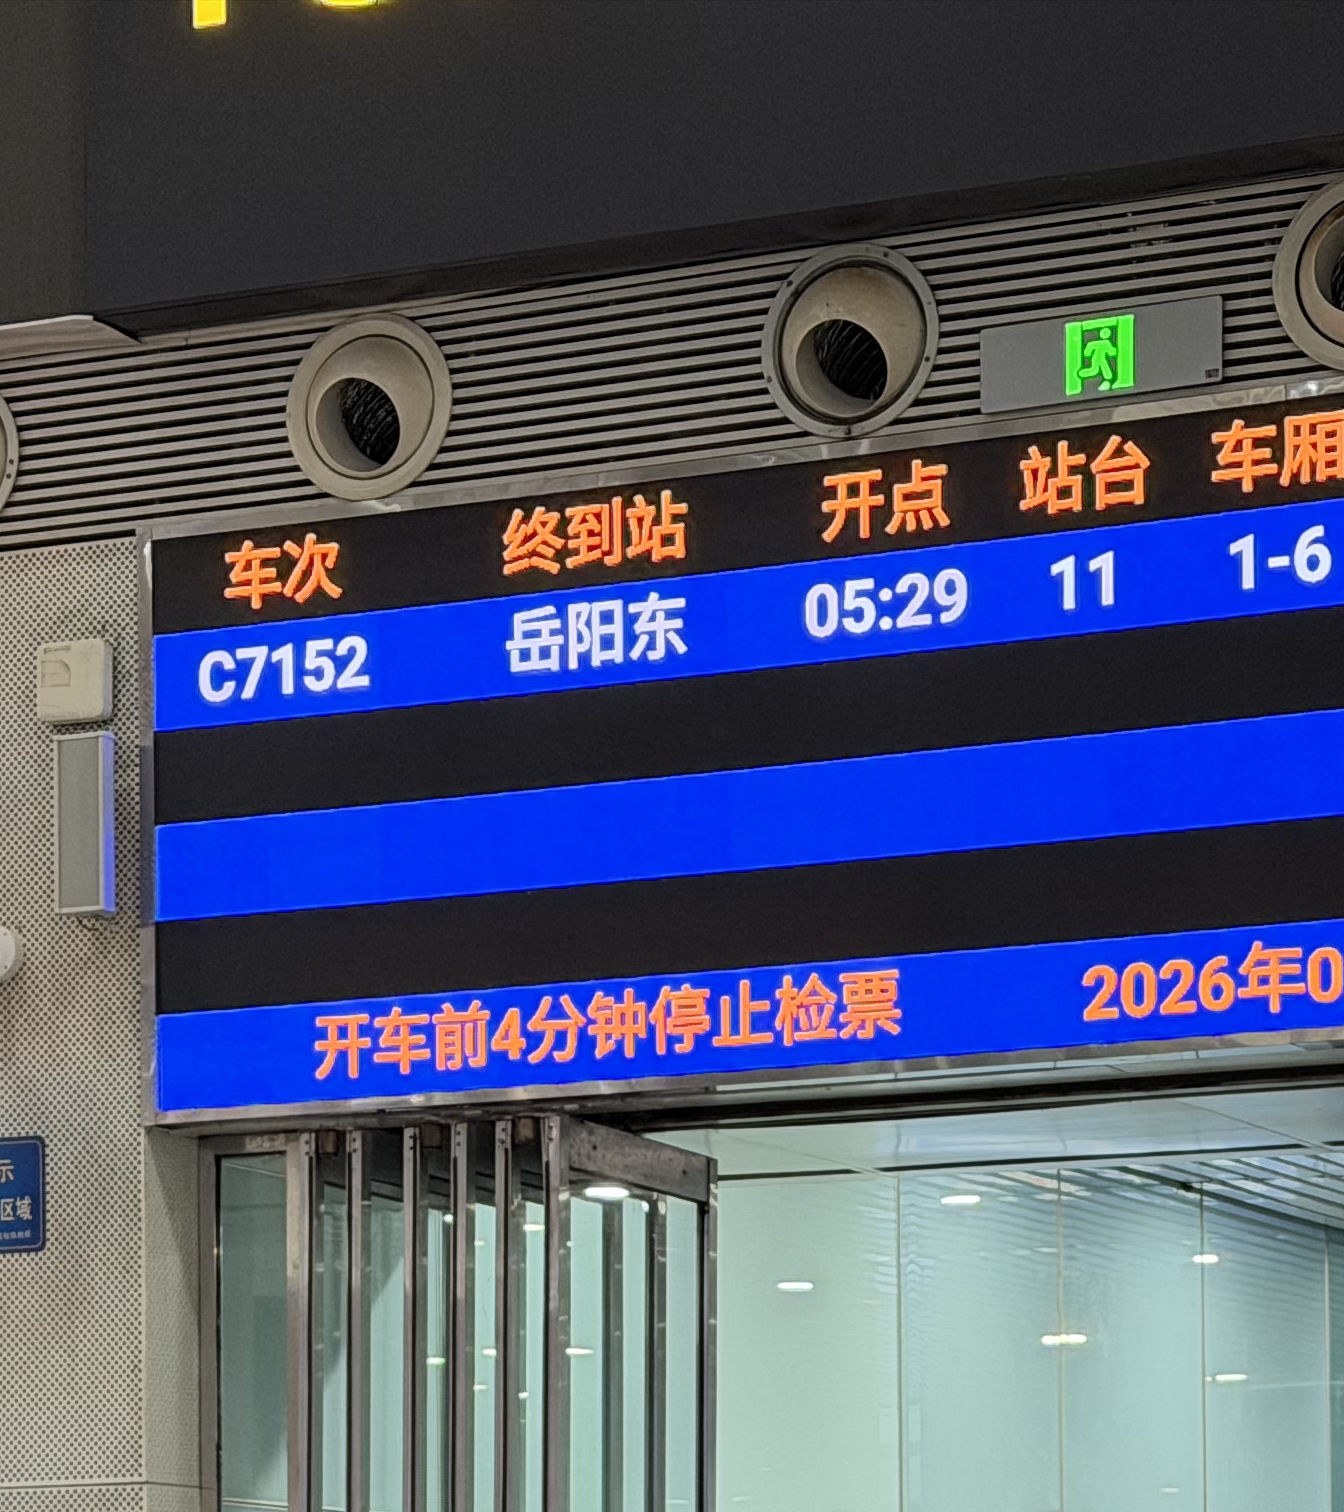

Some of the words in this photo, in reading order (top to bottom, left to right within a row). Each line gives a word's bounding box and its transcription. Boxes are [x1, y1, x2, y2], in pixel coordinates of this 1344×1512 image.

[223, 533, 344, 611] 车次
[501, 489, 689, 577] 终到站
[820, 458, 952, 544] 开点
[1018, 433, 1152, 516] 站台
[197, 634, 371, 704] C7152
[504, 590, 689, 674] 岳阳东
[803, 567, 969, 640] 05:29
[1049, 549, 1117, 612] 11
[1228, 524, 1333, 591] 1-6
[311, 966, 906, 1082] 开车前4分钟停止检票
